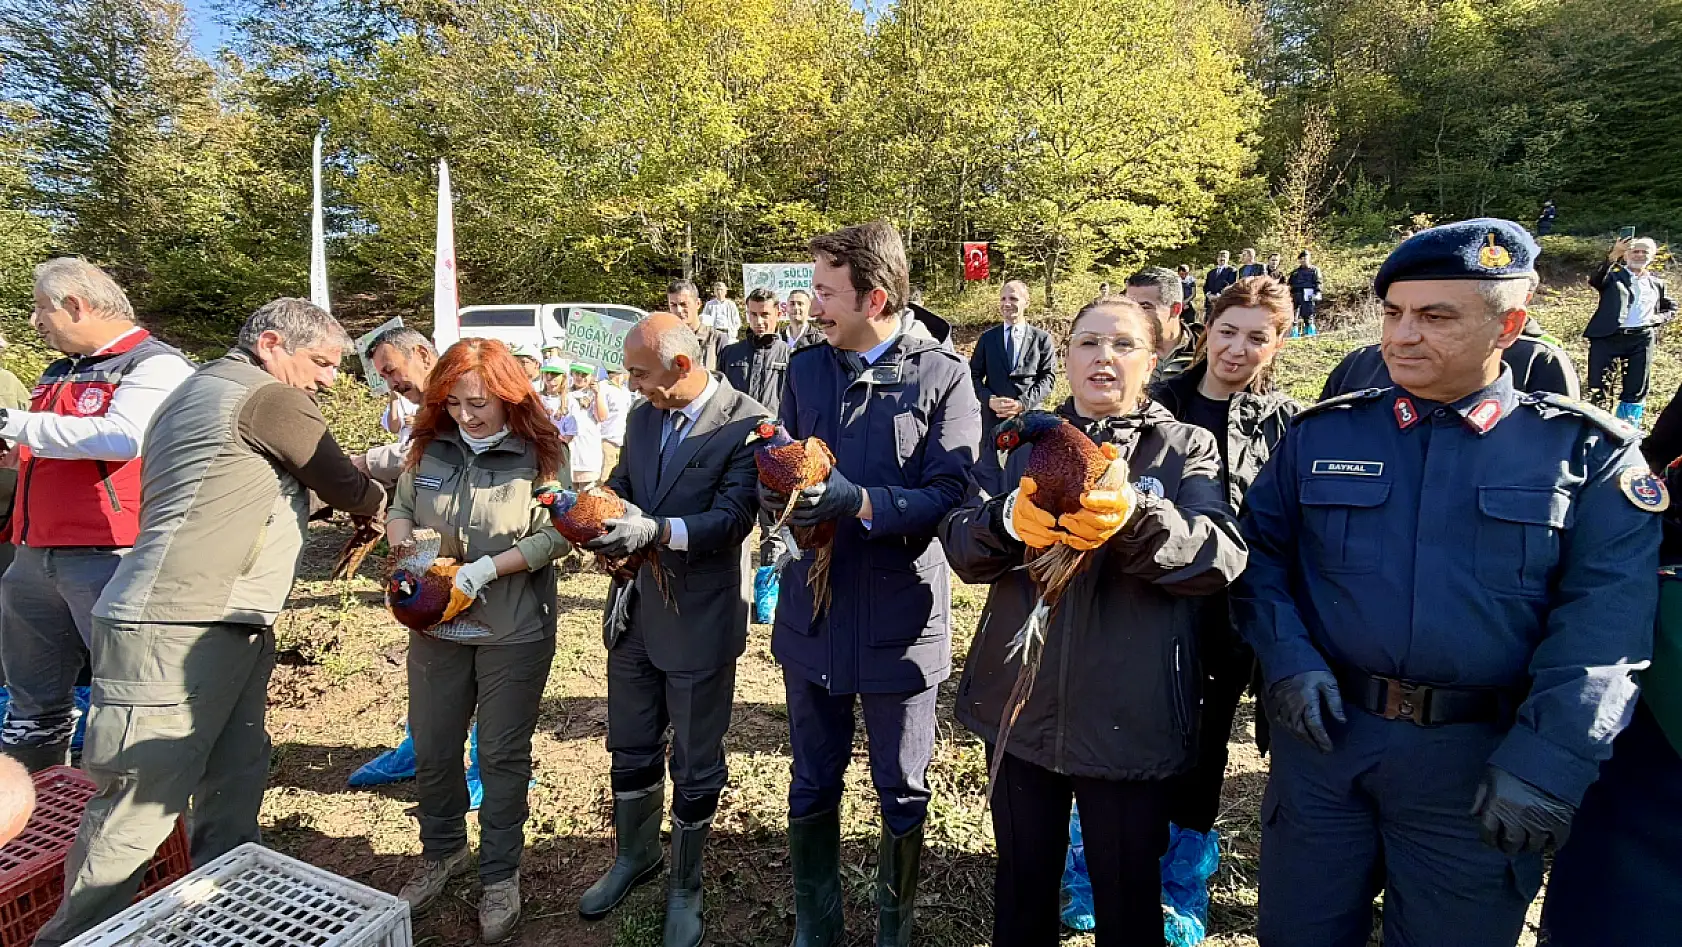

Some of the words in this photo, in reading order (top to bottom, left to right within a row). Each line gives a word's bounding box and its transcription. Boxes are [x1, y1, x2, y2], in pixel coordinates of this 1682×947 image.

[568, 322, 613, 346] DOĞAYI
[562, 339, 601, 360] YEŞİLİ
[1328, 463, 1367, 472] BAYKAL
